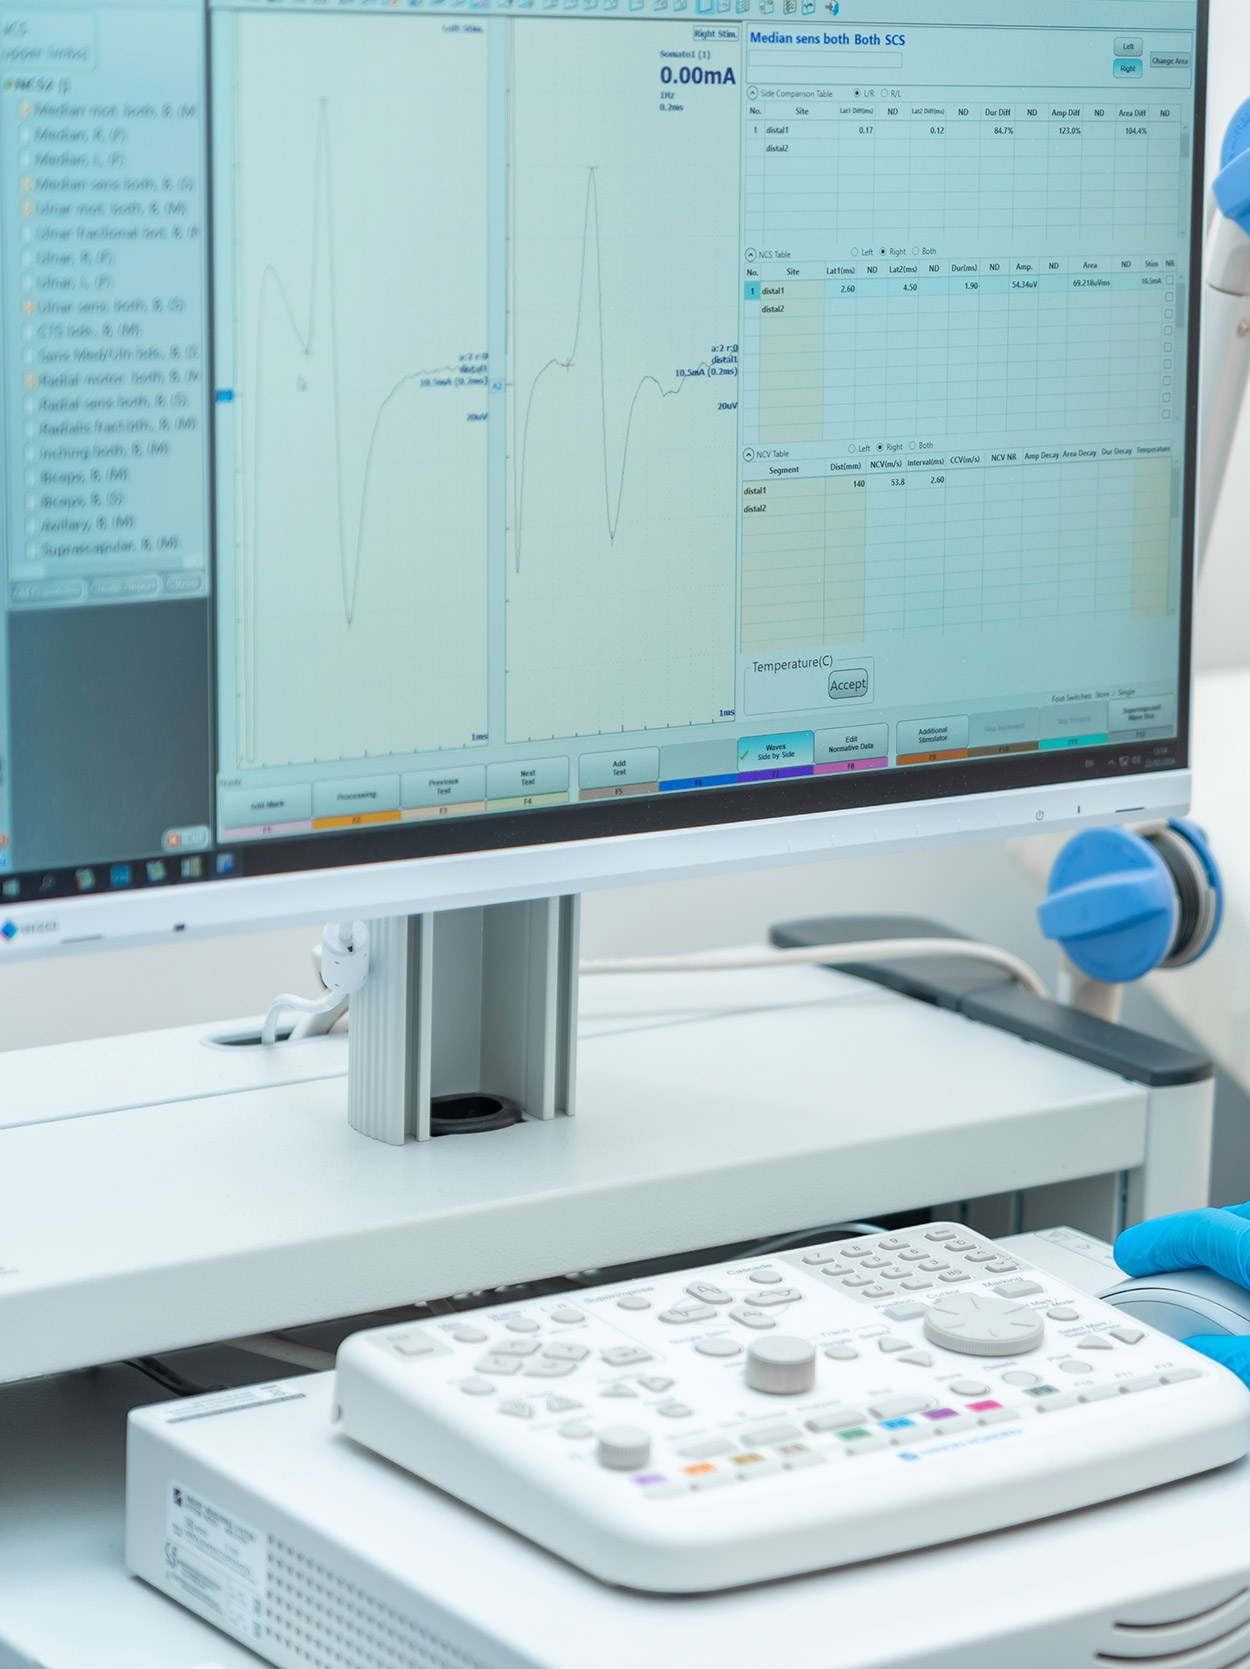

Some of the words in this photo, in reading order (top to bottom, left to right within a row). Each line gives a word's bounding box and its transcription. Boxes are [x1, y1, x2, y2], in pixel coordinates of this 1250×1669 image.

[750, 32, 792, 44] Median
[796, 34, 820, 44] sens
[823, 33, 850, 45] both
[854, 34, 881, 45] Both
[885, 35, 906, 46] SCS
[1123, 42, 1135, 50] Left
[697, 49, 711, 61] (1)
[1152, 57, 1173, 65] Change
[1174, 57, 1189, 65] Area
[1120, 65, 1136, 73] Right
[660, 66, 736, 85] 0.00mA
[660, 91, 675, 99] 1Hz
[760, 89, 775, 97] Side
[776, 89, 816, 98] Comparison
[818, 89, 833, 98] Table
[863, 89, 875, 97] L/R
[891, 89, 902, 98] R/L
[659, 103, 684, 111] 0.2ms
[749, 107, 762, 115] No.
[795, 107, 809, 115] Site
[887, 108, 899, 116] ND
[958, 108, 969, 116] ND
[1027, 109, 1038, 117] ND
[1051, 109, 1065, 118] Amp
[1066, 109, 1080, 117] Diff
[1094, 109, 1105, 117] ND
[754, 126, 758, 134] 1
[766, 126, 789, 134] distal1
[859, 126, 874, 134] 0.17
[930, 126, 945, 134] 0.12
[994, 127, 1014, 135] 84.7%
[1059, 127, 1081, 135] 123.0%
[1125, 127, 1147, 135] 104.4%
[766, 144, 789, 153] distal2
[759, 251, 774, 259] NCS
[775, 251, 791, 259] Table
[889, 248, 906, 256] Right
[922, 247, 937, 255] Both
[989, 263, 1000, 271] ND
[1049, 262, 1059, 270] ND
[1121, 260, 1132, 268] ND
[1145, 260, 1159, 268] Stim
[1165, 259, 1175, 267] NR
[826, 266, 856, 275] Lat1(ms)
[867, 266, 878, 274] ND
[889, 265, 918, 274] Lat2(ms)
[928, 265, 940, 273] ND
[951, 263, 978, 273] Dur(ms)
[1016, 263, 1033, 272] Amp.
[746, 268, 759, 276] No.
[786, 268, 800, 276] Site
[903, 283, 918, 291] 4.50
[965, 282, 979, 290] 1.90
[1012, 280, 1038, 289] 54.34uV
[751, 287, 754, 295] 1
[761, 287, 784, 295] distal1
[841, 285, 856, 293] 2.60
[761, 305, 784, 313] distal2
[711, 355, 738, 364] distal1
[717, 401, 738, 410] 20uV
[858, 445, 871, 453] Left
[886, 443, 903, 451] Right
[918, 441, 934, 450] Both
[756, 451, 771, 459] NCV
[774, 450, 789, 458] Table
[1024, 452, 1039, 460] Amp
[1041, 451, 1059, 460] Decay
[1062, 450, 1077, 458] Area
[1078, 449, 1097, 458] Decay
[1101, 448, 1112, 456] Dur
[1114, 447, 1132, 456] Decay
[950, 455, 980, 464] CCV(m/s)
[991, 454, 1005, 462] NCV
[1007, 453, 1017, 461] NR
[870, 460, 902, 469] NCV(m/s)
[907, 457, 944, 467] Interval(ms)
[769, 465, 799, 476] Segment
[830, 462, 861, 471] Dist(mm)
[853, 480, 865, 488] 140
[891, 478, 905, 486] 53.8
[930, 476, 945, 484] 2.60
[744, 487, 766, 496] distal1
[744, 504, 766, 513] distal2
[752, 655, 833, 674] Temperature(C)
[830, 678, 866, 692] Accept
[719, 709, 735, 717] 1ms
[918, 726, 948, 736] Additional
[918, 735, 948, 744] Stimulator
[766, 743, 786, 751] Waves
[828, 744, 859, 753] Normative
[860, 742, 874, 750] Data
[757, 753, 770, 761] Side
[771, 752, 780, 760] by
[612, 760, 626, 768] Add
[847, 762, 855, 770] F8
[520, 769, 536, 777] Next
[982, 1276, 1024, 1288] Marking
[926, 1288, 962, 1299] Cursor
